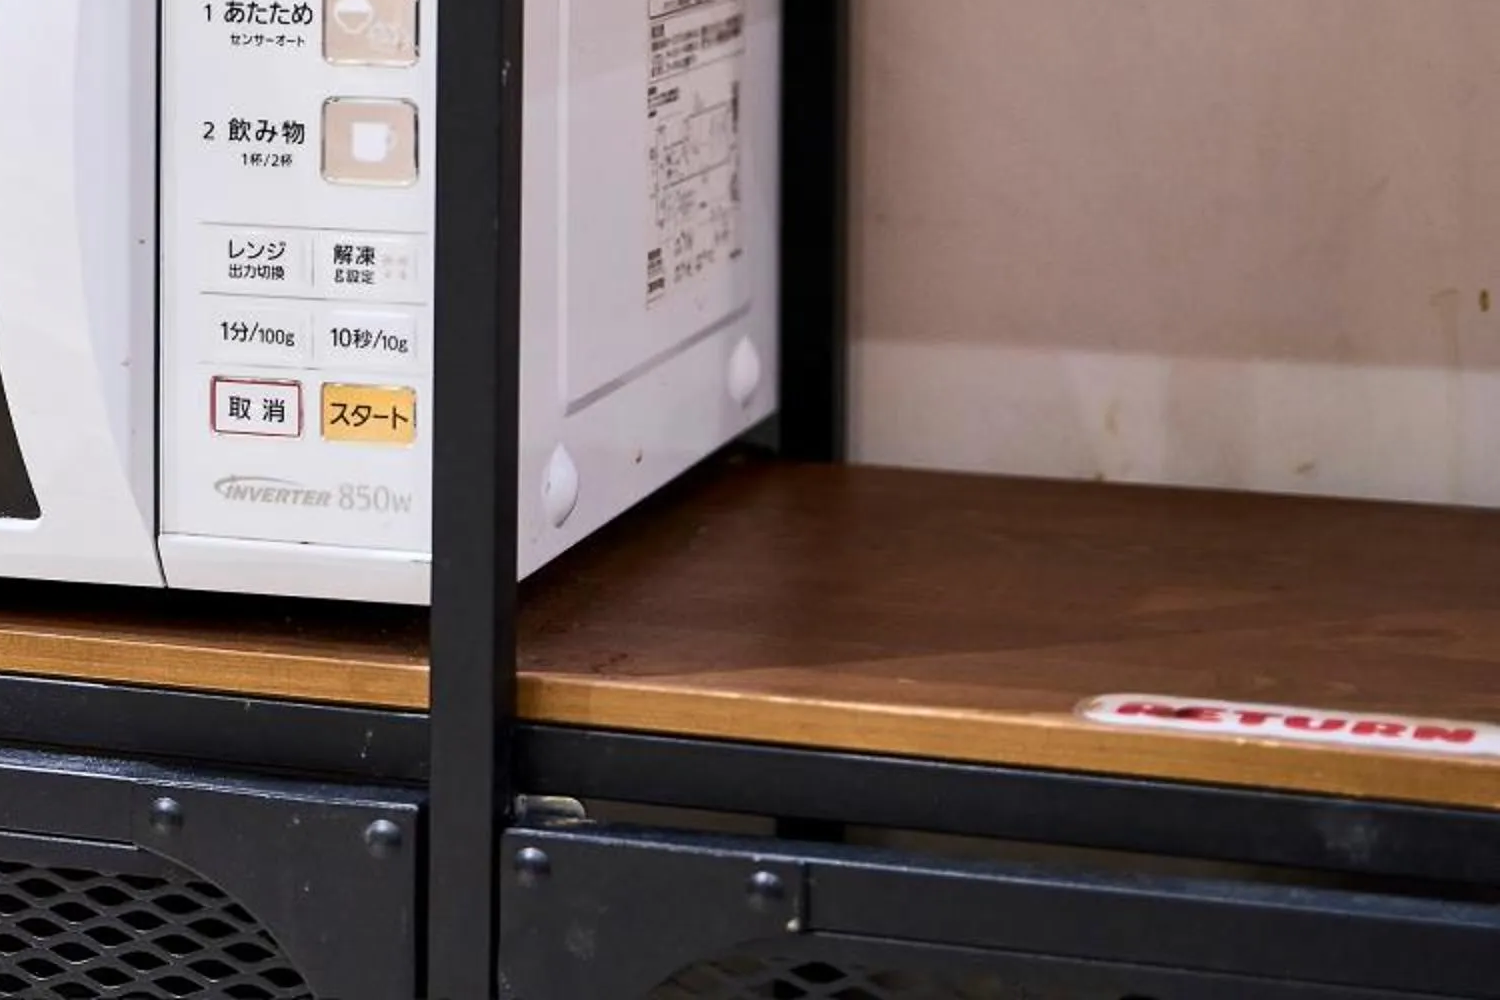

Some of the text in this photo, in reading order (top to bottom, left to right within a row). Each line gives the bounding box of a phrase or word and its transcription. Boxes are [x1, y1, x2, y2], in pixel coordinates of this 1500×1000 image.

[203, 1, 313, 25] 1 あたため
[230, 33, 305, 47] センサーオート
[203, 118, 305, 144] 2 飲み物
[242, 153, 293, 167] 1杯/2杯
[228, 239, 286, 261] レンジ
[333, 244, 375, 266] 解凍
[228, 264, 285, 281] 出力切換
[220, 321, 296, 347] 1分/100g
[330, 328, 409, 353] 10秒/10g
[329, 402, 409, 430] スタート
[1116, 702, 1476, 743] RETURN
